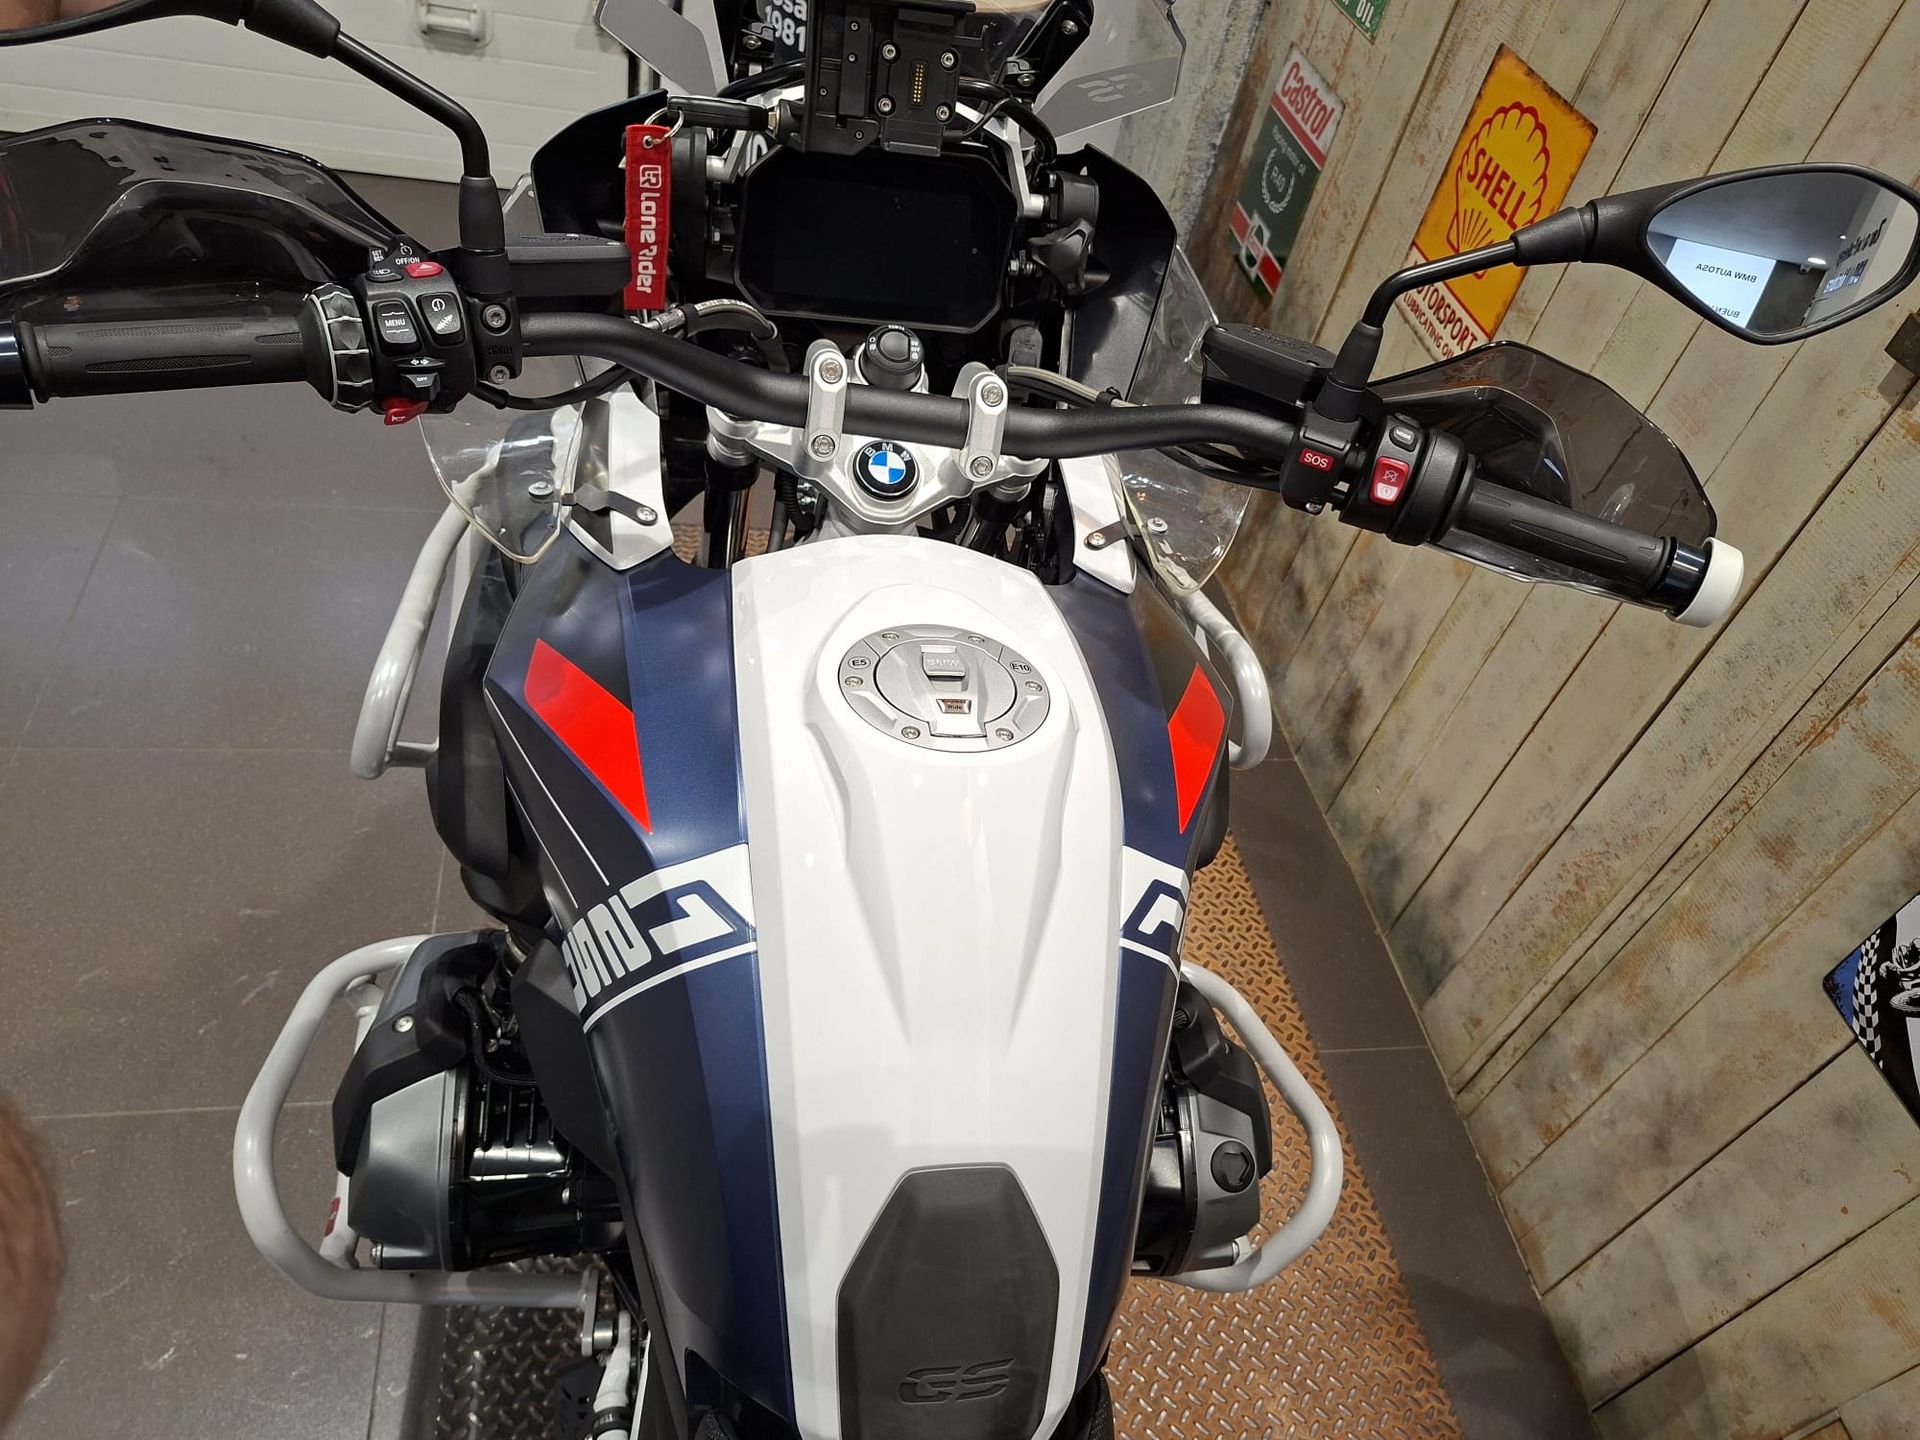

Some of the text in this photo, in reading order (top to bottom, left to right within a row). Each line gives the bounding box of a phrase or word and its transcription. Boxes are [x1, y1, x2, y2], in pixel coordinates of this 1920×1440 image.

[1355, 0, 1375, 28] OIL
[765, 5, 806, 53] 1981
[1281, 60, 1335, 141] Castrol
[1466, 147, 1527, 231] SHELL
[395, 257, 421, 266] OFF/ON
[1403, 291, 1444, 349] LUBRICATING
[1414, 261, 1478, 352] TORSPORT
[384, 318, 406, 328] MENU
[864, 442, 912, 462] BMW
[1303, 452, 1329, 468] SOS
[851, 658, 867, 668] E5
[1011, 662, 1030, 673] E10
[900, 1358, 1015, 1404] GS
